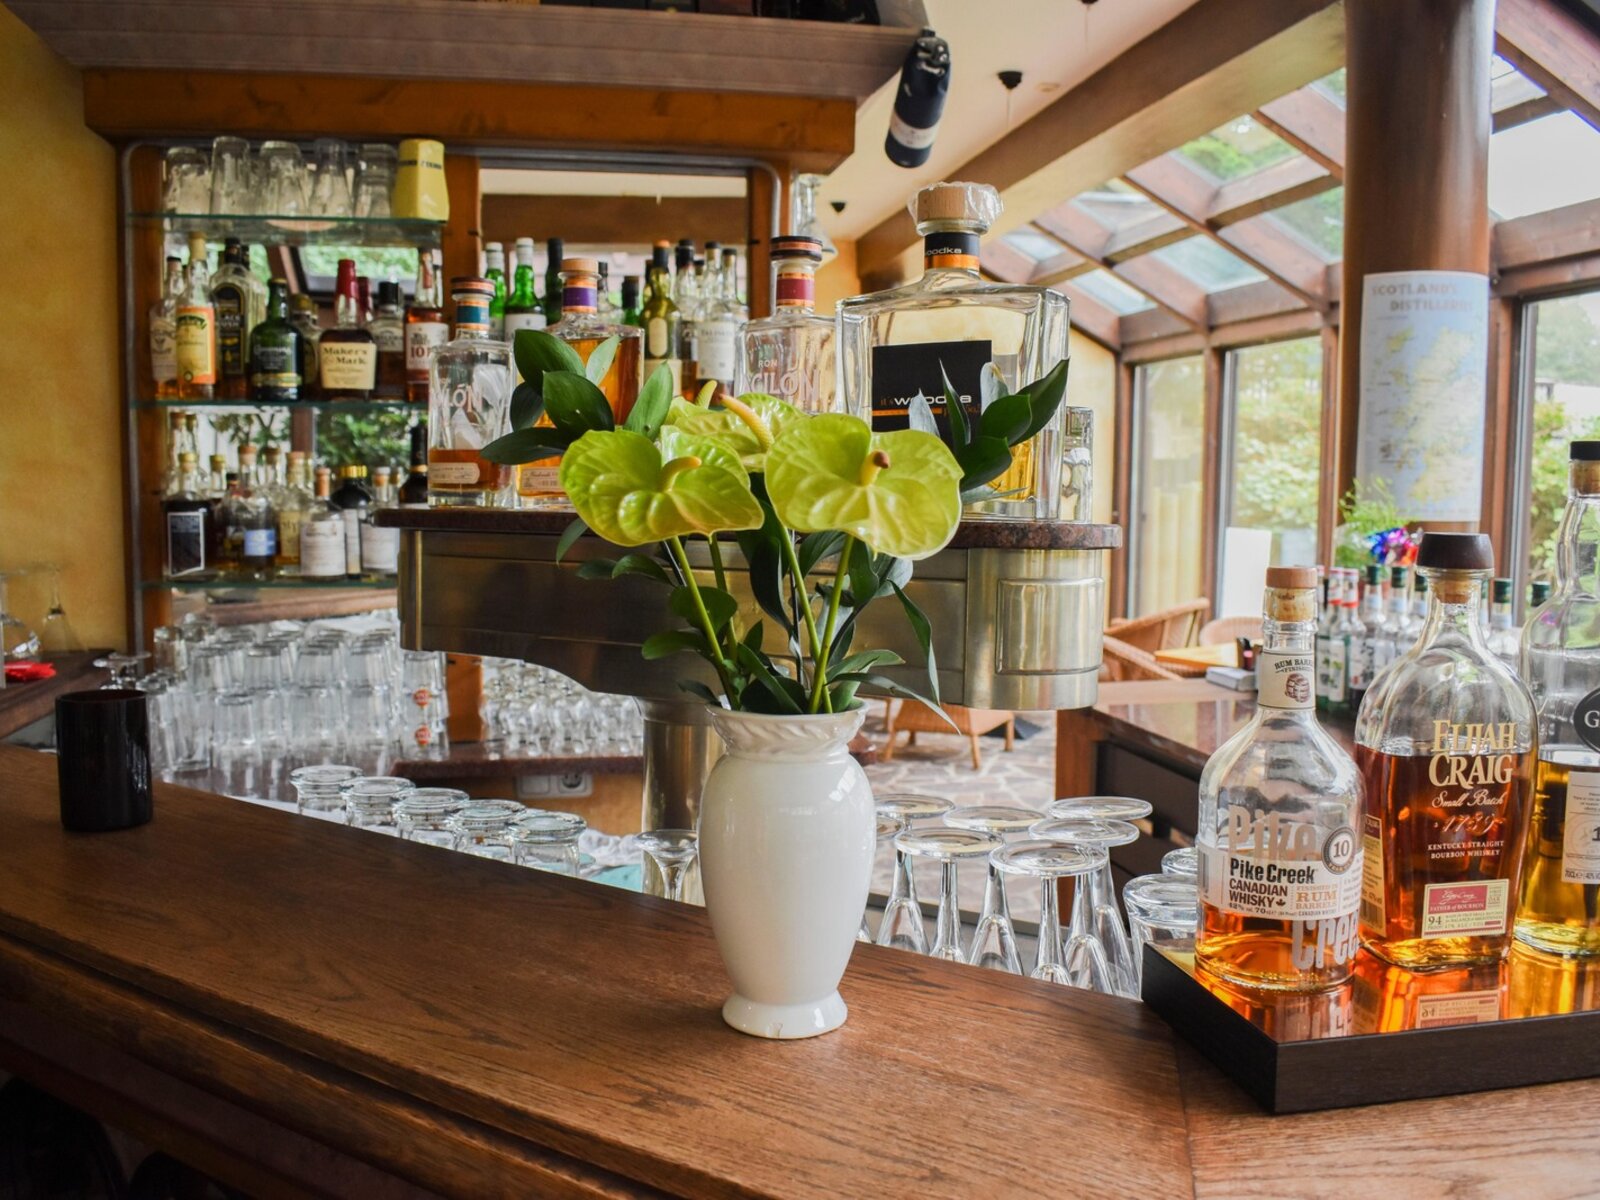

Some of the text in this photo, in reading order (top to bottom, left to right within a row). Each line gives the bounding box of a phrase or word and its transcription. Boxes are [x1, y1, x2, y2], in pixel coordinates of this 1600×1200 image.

[926, 246, 963, 256] oodka
[758, 360, 778, 368] RON
[894, 394, 972, 406] woda
[1274, 660, 1292, 670] RUM
[1431, 719, 1517, 756] ELIJAH
[1428, 751, 1513, 790] CRAIG
[1431, 788, 1508, 809] Small Batch
[1333, 839, 1350, 858] 10
[1428, 840, 1505, 851] KENTUCKY STRAIGHT
[1431, 849, 1501, 859] BOURBON WHISKEY
[1230, 857, 1264, 881] Pike
[1266, 864, 1315, 884] Creek
[1229, 878, 1288, 897] CANADIAN
[1229, 890, 1275, 908] WHISKY
[1296, 891, 1337, 902] RUM
[1428, 915, 1442, 925] 94
[1292, 912, 1359, 970] Cree
